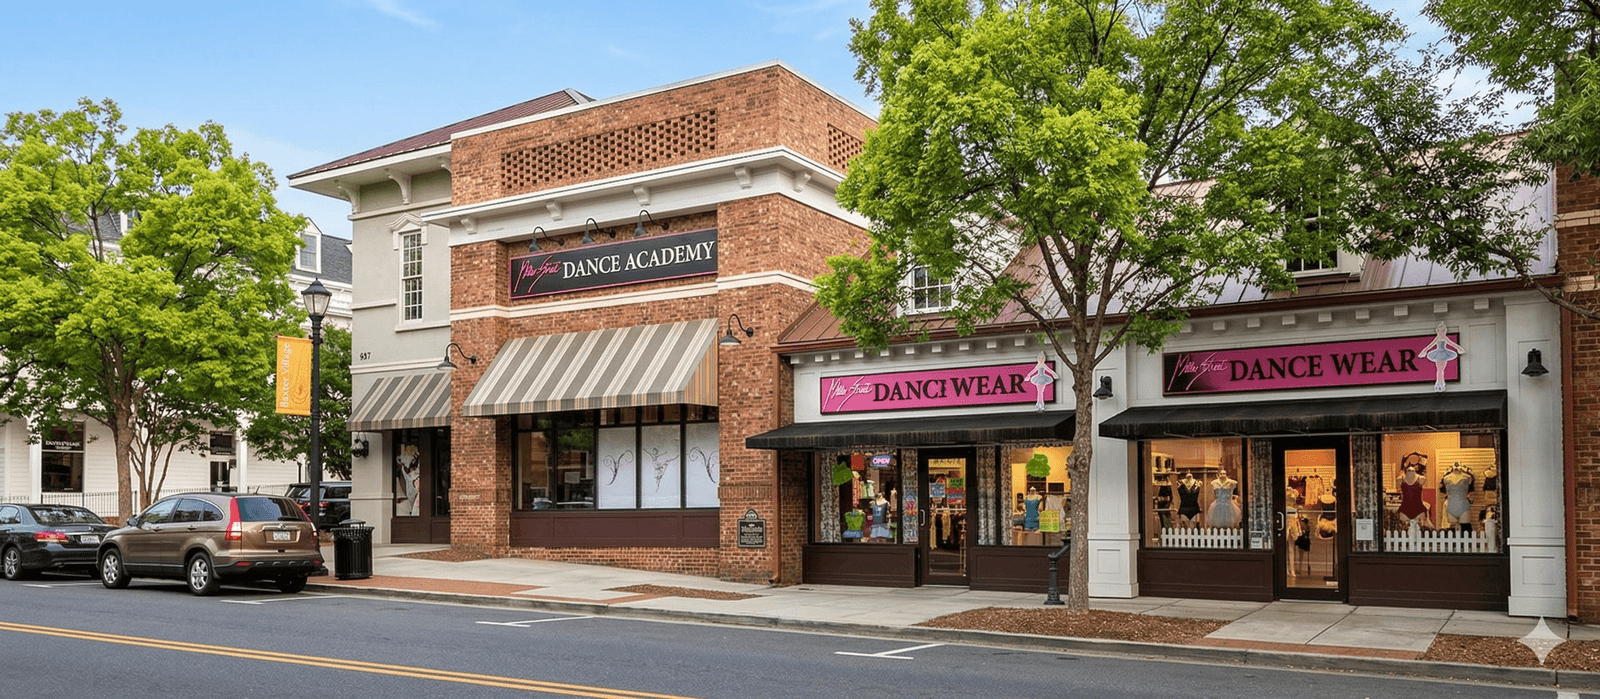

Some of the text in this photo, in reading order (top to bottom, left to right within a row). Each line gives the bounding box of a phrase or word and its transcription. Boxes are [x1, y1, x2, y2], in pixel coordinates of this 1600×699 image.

[563, 254, 621, 279] DANCE
[624, 241, 716, 272] ACADEMY
[280, 343, 292, 408] Baxter Village
[1229, 354, 1324, 382] DANCE
[1330, 348, 1419, 376] WEAR
[950, 373, 1028, 398] WEAR
